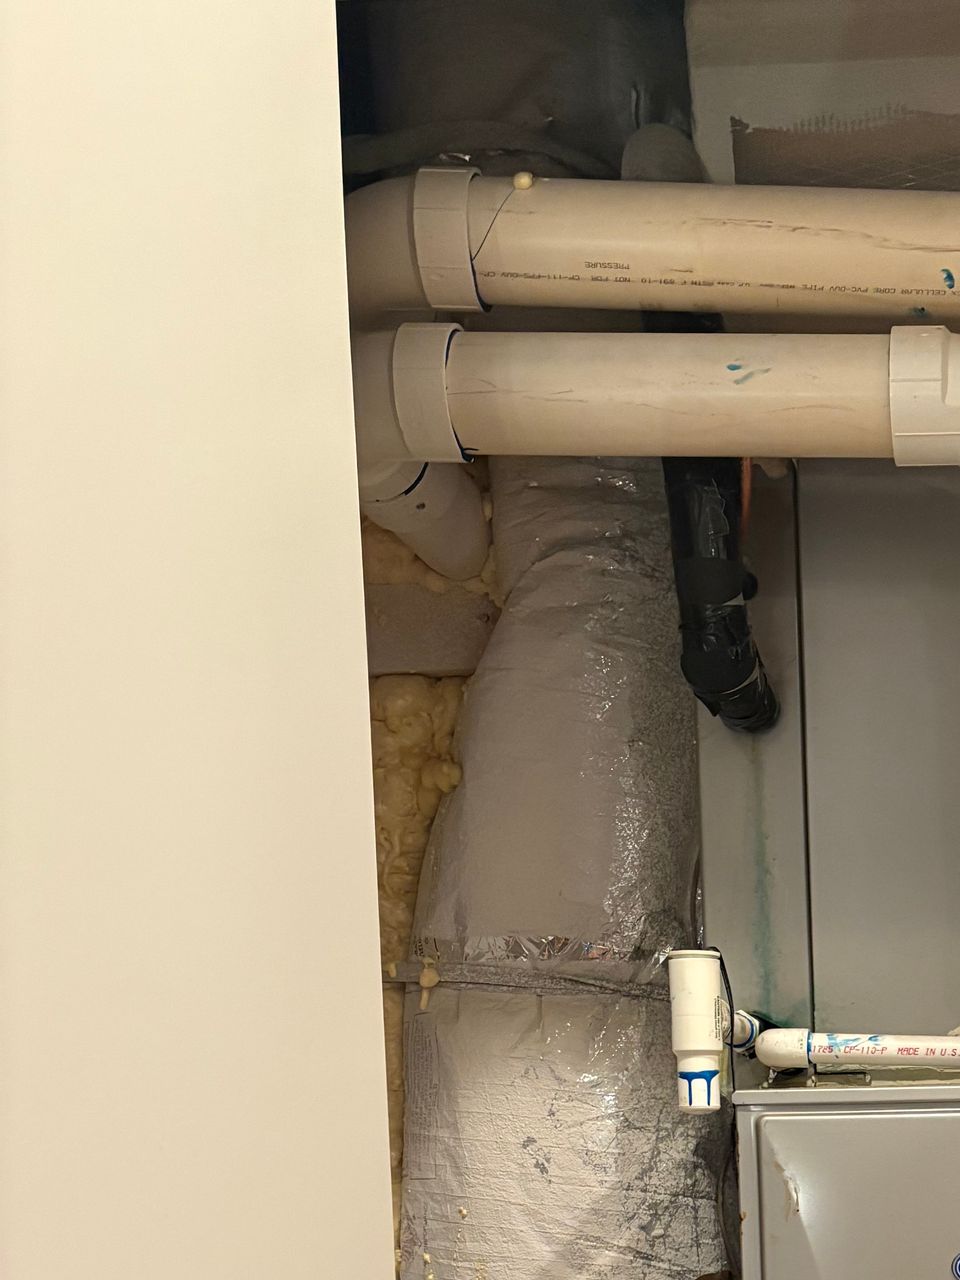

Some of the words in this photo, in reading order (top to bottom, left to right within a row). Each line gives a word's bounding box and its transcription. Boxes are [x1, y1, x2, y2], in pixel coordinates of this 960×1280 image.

[584, 261, 630, 270] PRESSURE
[873, 287, 896, 295] CORE
[900, 288, 947, 297] CELLULAR
[896, 1046, 920, 1057] MADE
[924, 1046, 937, 1057] IN
